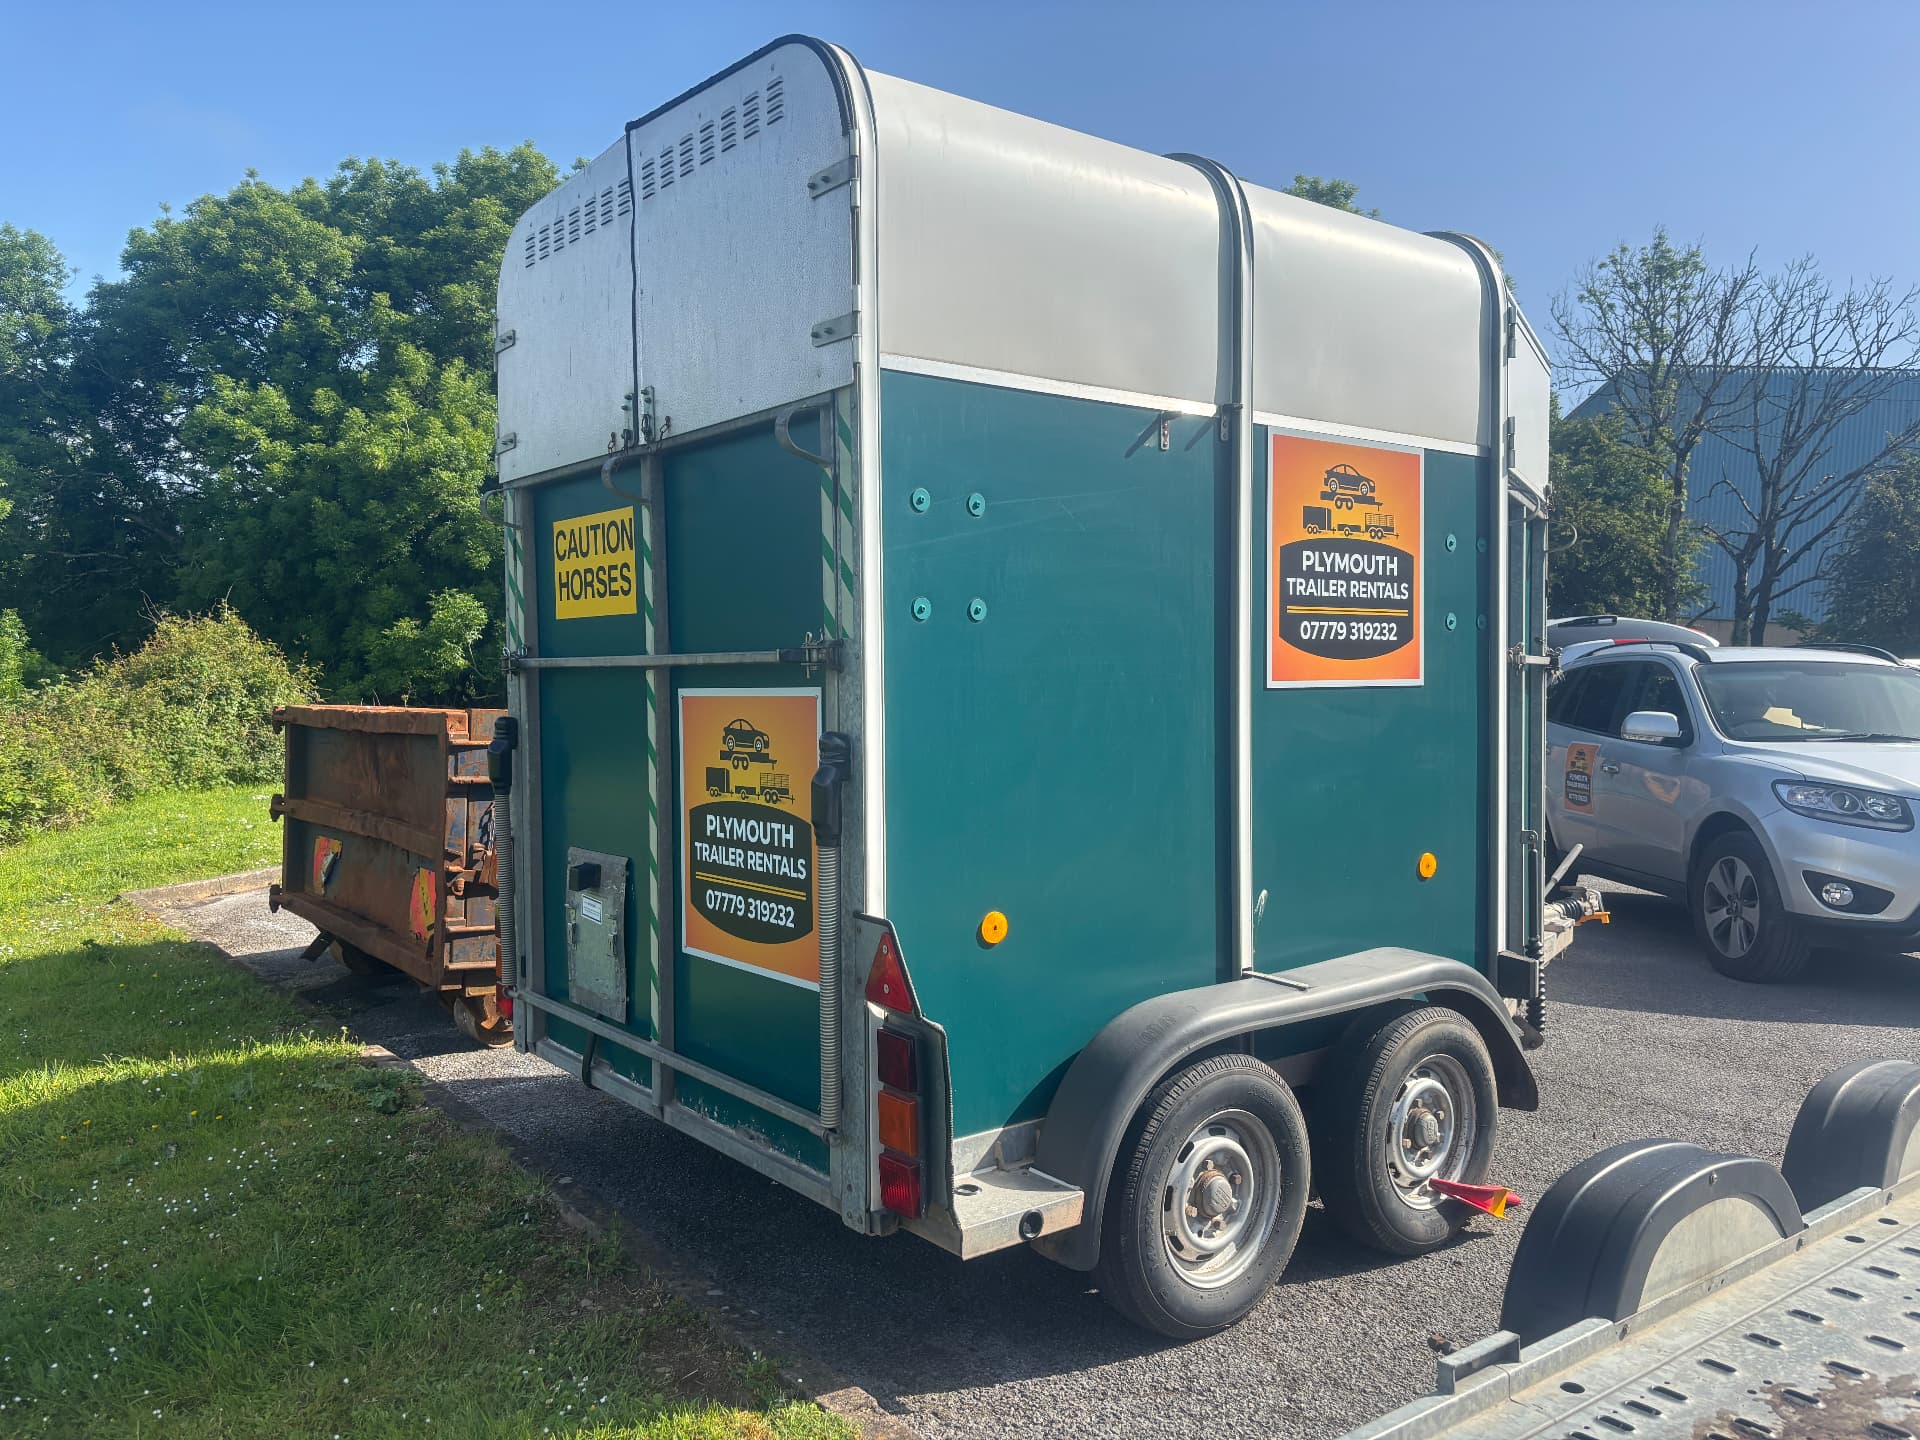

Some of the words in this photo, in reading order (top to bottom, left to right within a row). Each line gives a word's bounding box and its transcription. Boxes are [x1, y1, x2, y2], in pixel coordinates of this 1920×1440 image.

[556, 518, 633, 561] CAUTION
[1302, 550, 1398, 576] PLYMOUTH
[559, 562, 632, 601] HORSES
[1286, 577, 1347, 597] TRAILER
[1350, 580, 1409, 600] RENTALS
[1300, 620, 1347, 640] 07779
[1350, 622, 1398, 640] 319232
[706, 814, 794, 848] PLYMOUTH
[694, 841, 744, 869] TRAILER
[747, 850, 807, 879] RENTALS
[706, 889, 745, 916] 07779
[747, 898, 795, 928] 319232
